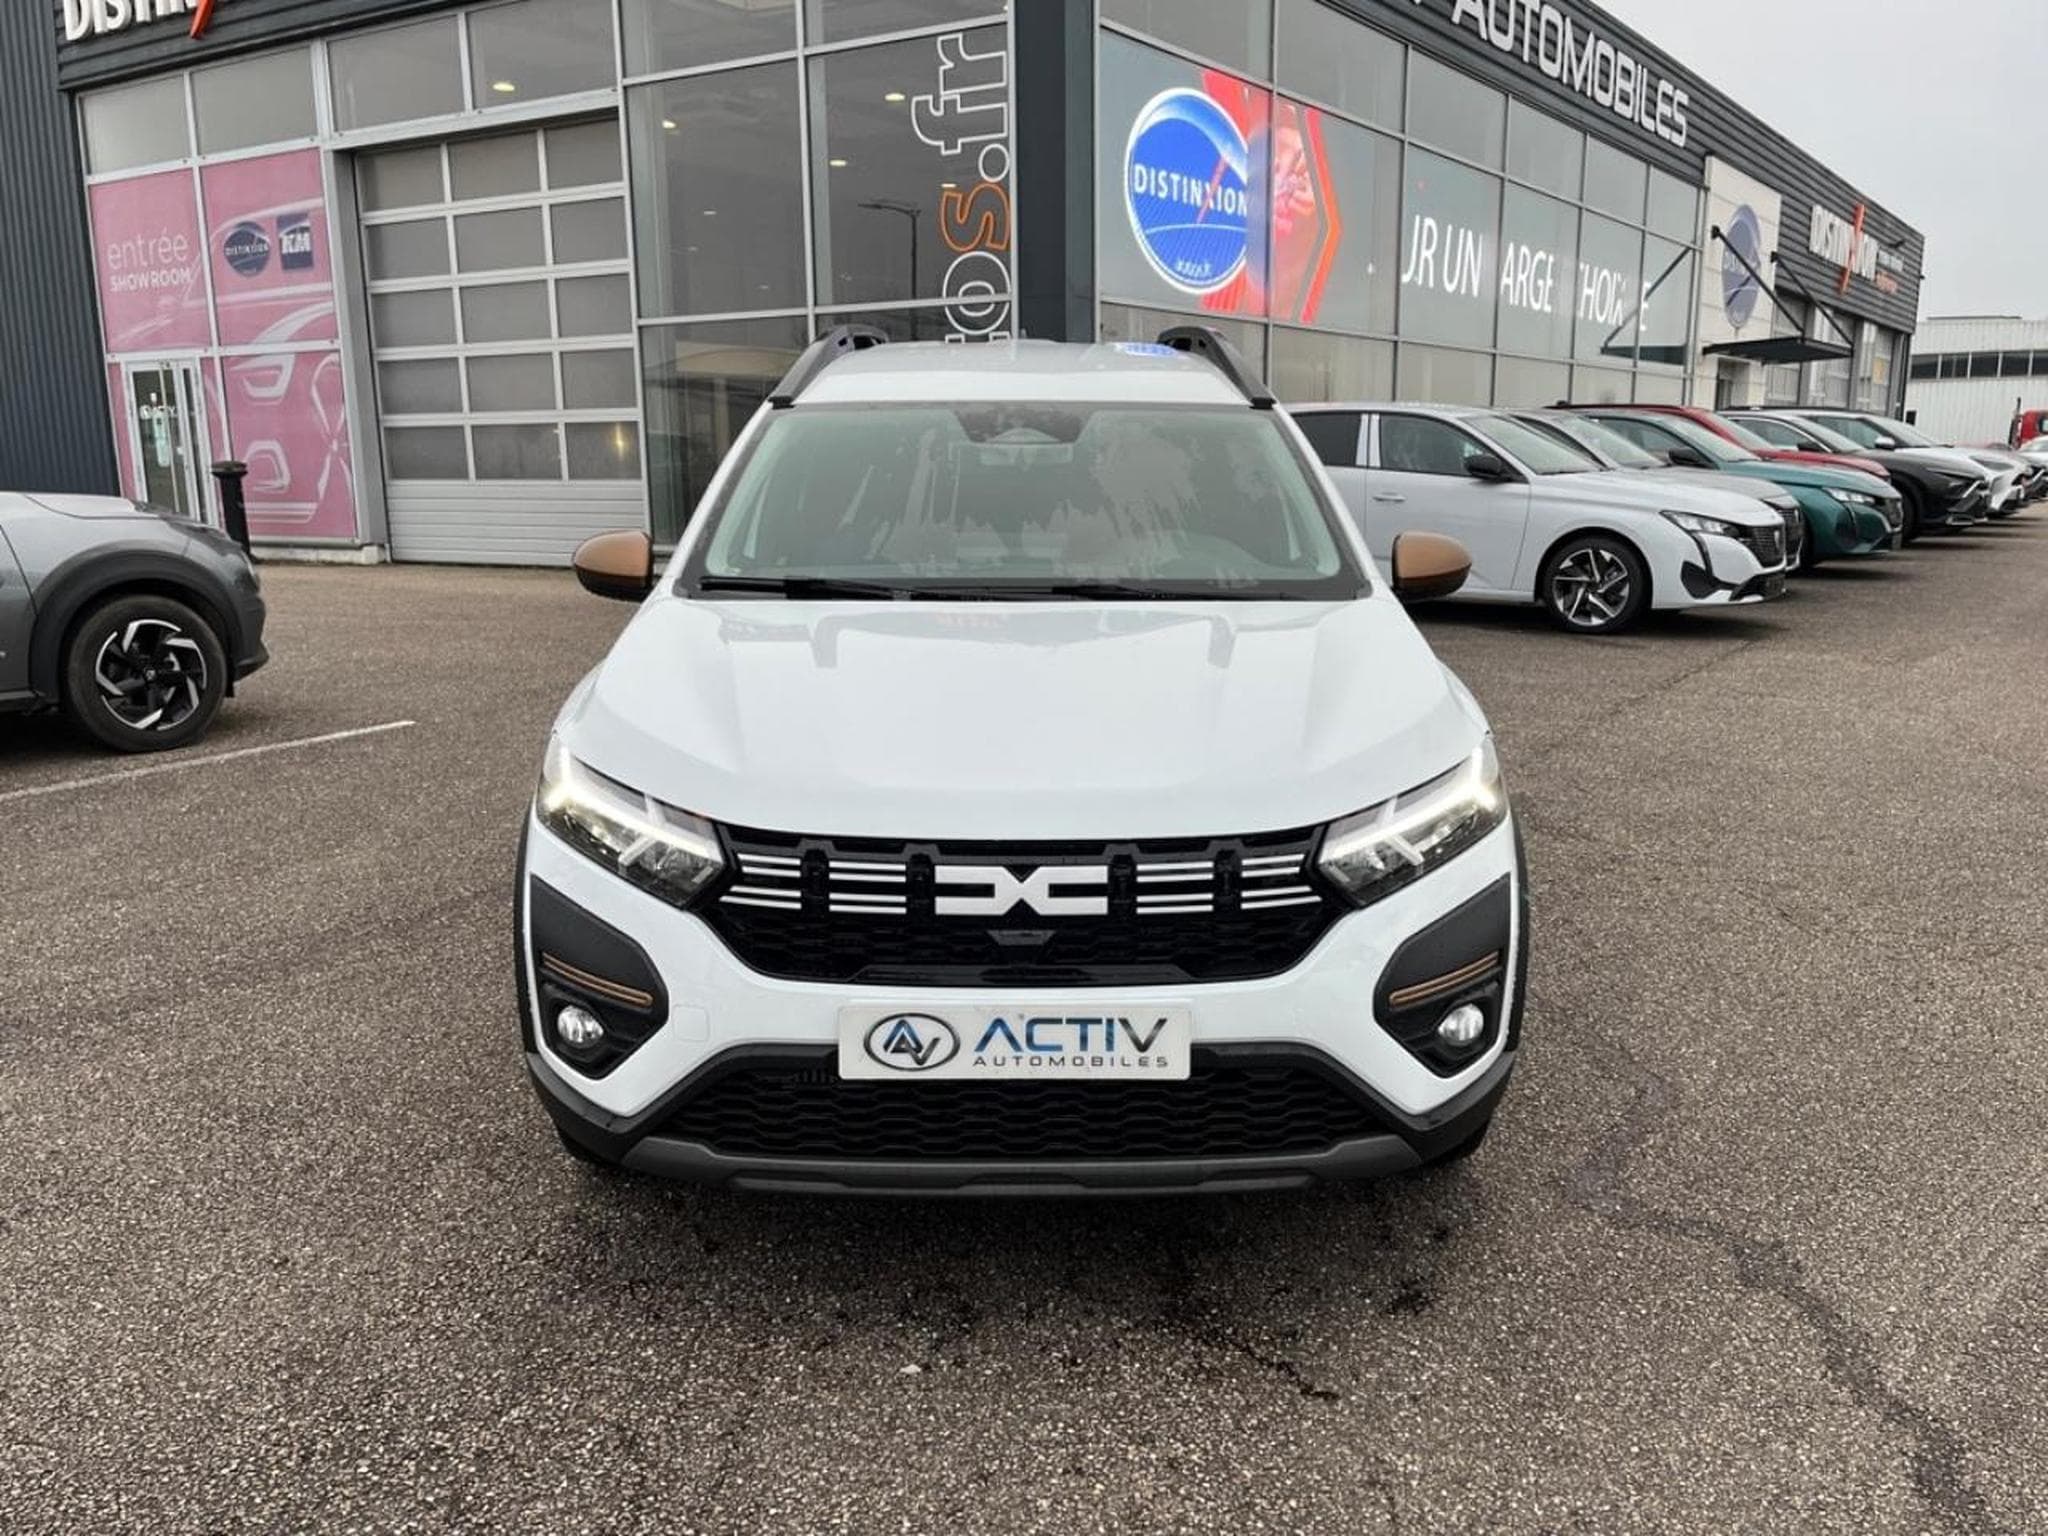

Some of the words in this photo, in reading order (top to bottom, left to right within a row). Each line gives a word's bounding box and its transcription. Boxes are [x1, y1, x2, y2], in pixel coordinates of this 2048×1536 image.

[1452, 0, 1689, 148] AUTOMOBILES
[911, 32, 1011, 343] os.fr
[107, 227, 188, 270] entrée
[1442, 223, 1483, 298] UN
[110, 268, 193, 293] SHOWROOM
[973, 1017, 1168, 1053] ACTIV
[972, 1056, 1169, 1068] AUTOMOBILES
